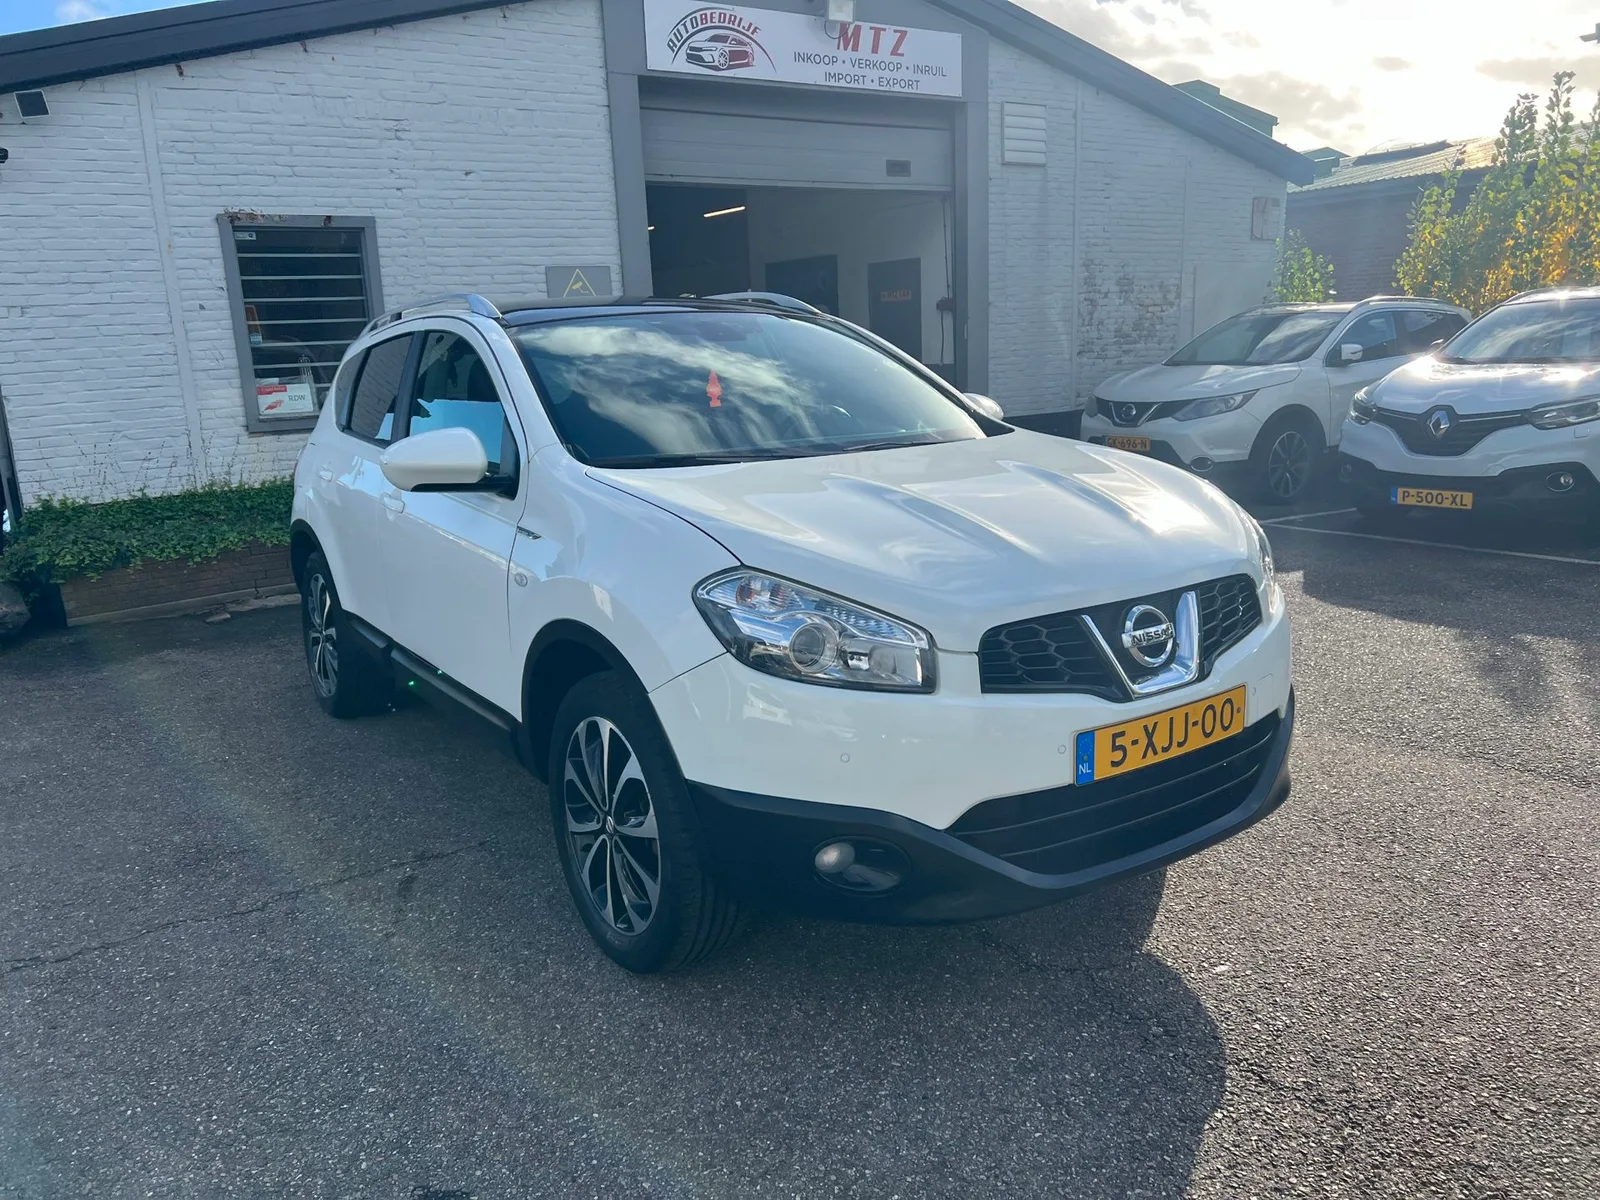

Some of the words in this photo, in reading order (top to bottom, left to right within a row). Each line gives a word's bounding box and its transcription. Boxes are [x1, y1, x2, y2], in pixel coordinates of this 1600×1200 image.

[667, 11, 761, 53] AUTOBEDRIJF
[837, 22, 908, 57] MTZ
[793, 51, 839, 67] INKOOP
[850, 57, 903, 72] VERKOOP
[913, 64, 947, 77] INRUIL
[824, 71, 867, 85] IMPORT
[878, 77, 921, 90] EXPORT
[288, 394, 306, 402] RDW
[1402, 490, 1468, 507] P-500-XL
[1078, 762, 1092, 775] NL
[1110, 697, 1235, 768] 5-XJJ-00
